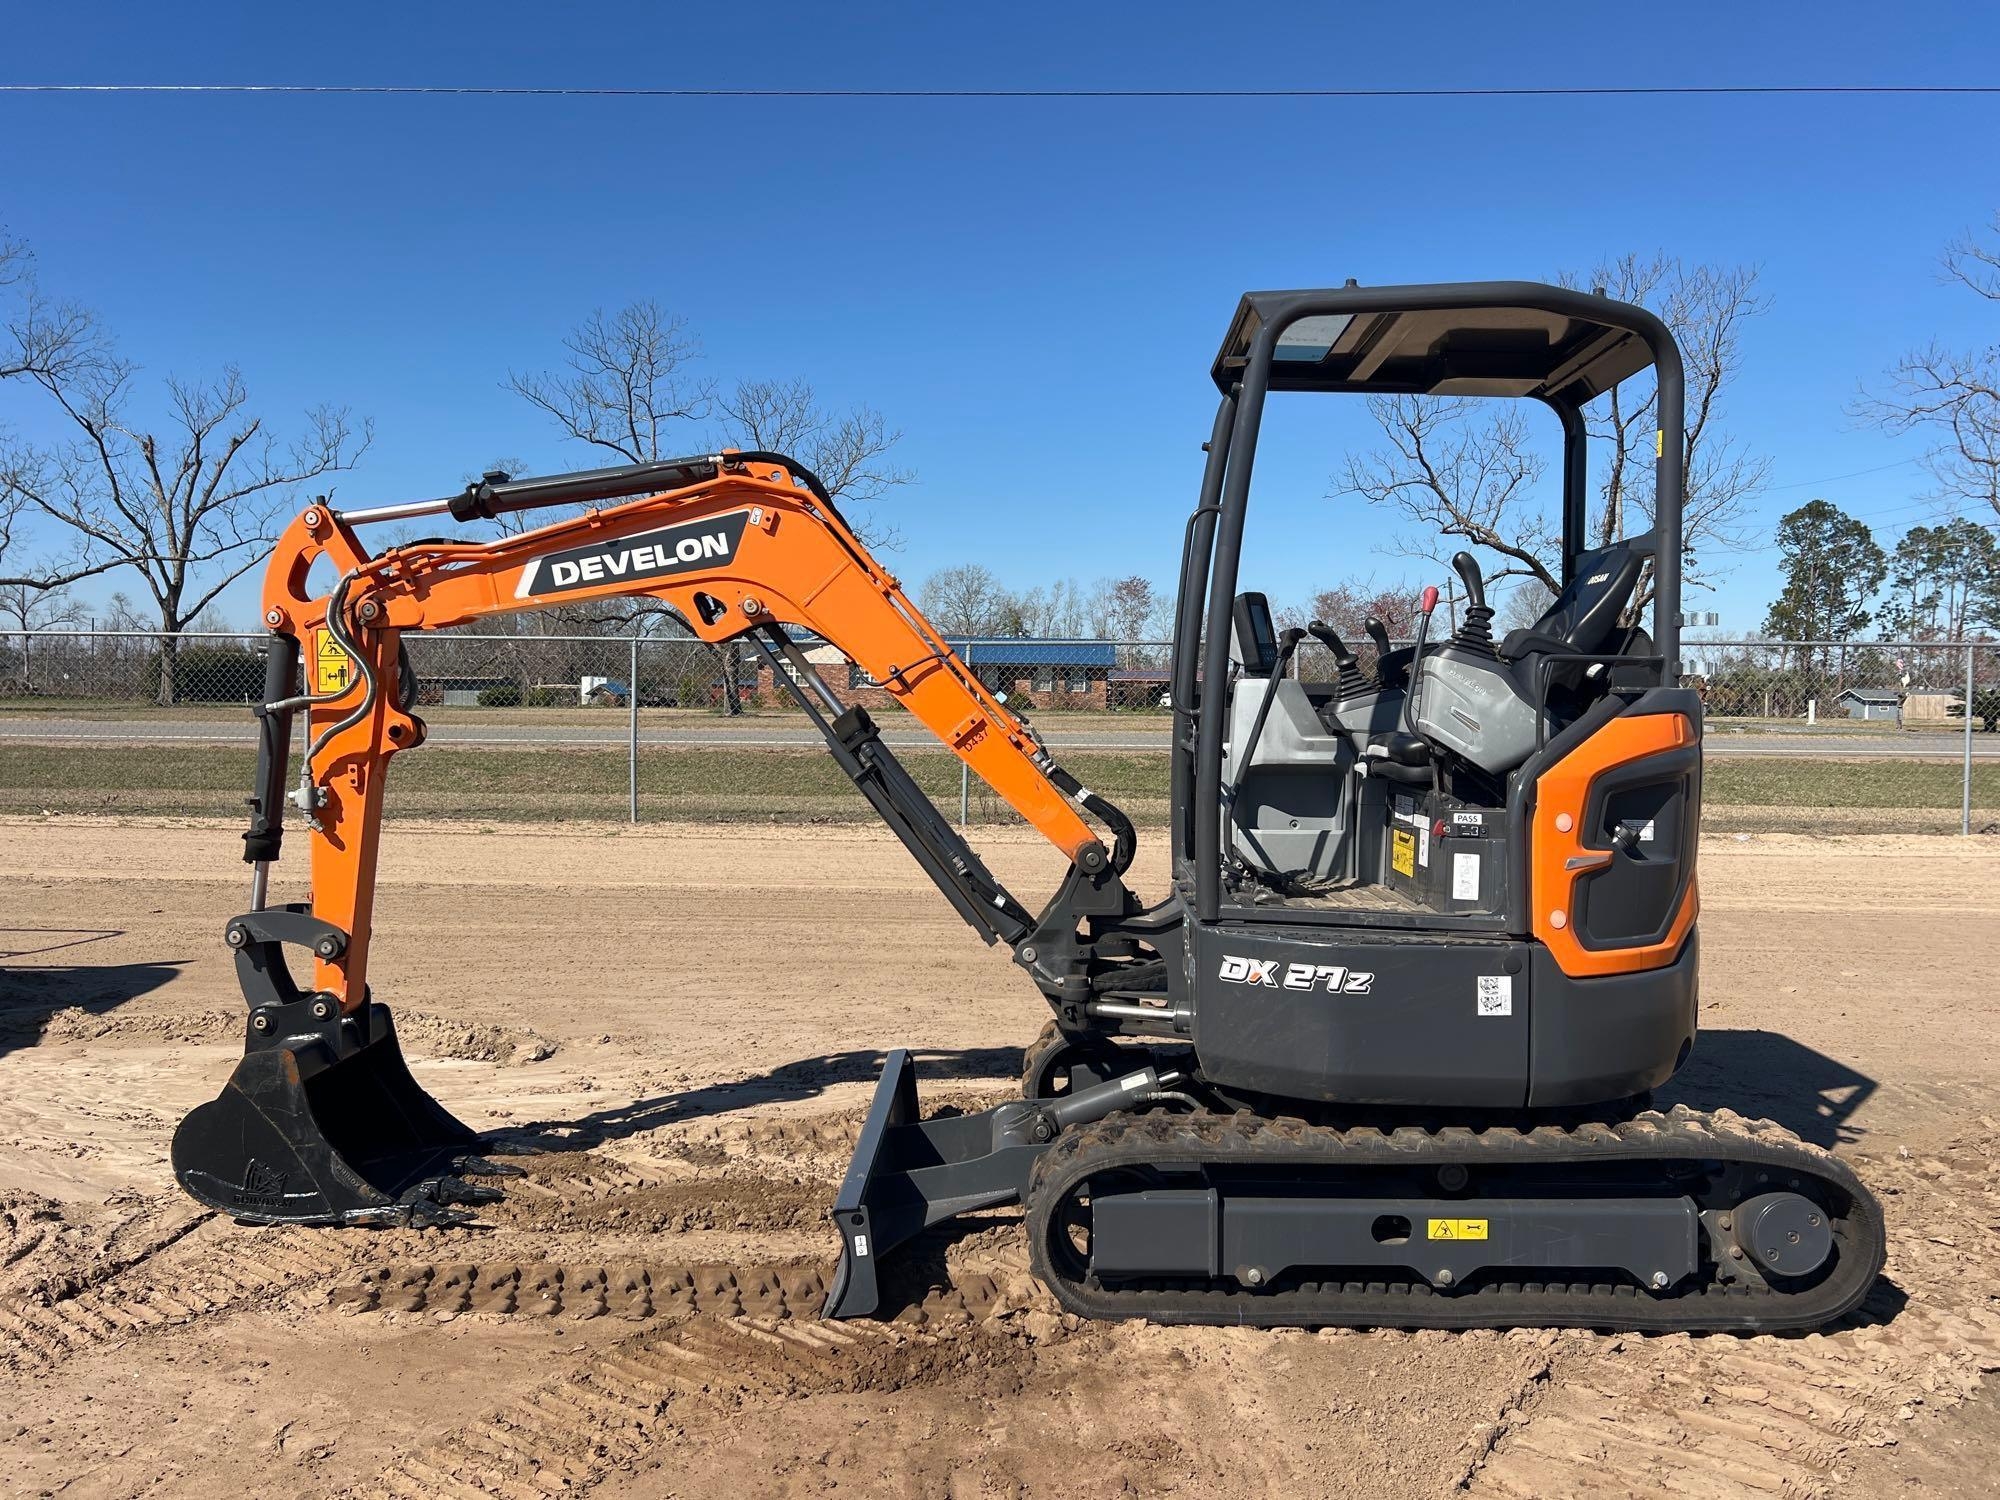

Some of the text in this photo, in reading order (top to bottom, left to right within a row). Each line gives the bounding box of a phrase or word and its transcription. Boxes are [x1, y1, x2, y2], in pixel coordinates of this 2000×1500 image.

[550, 532, 729, 587] DEVELON
[1457, 814, 1478, 823] PASS
[1218, 955, 1280, 988] DX
